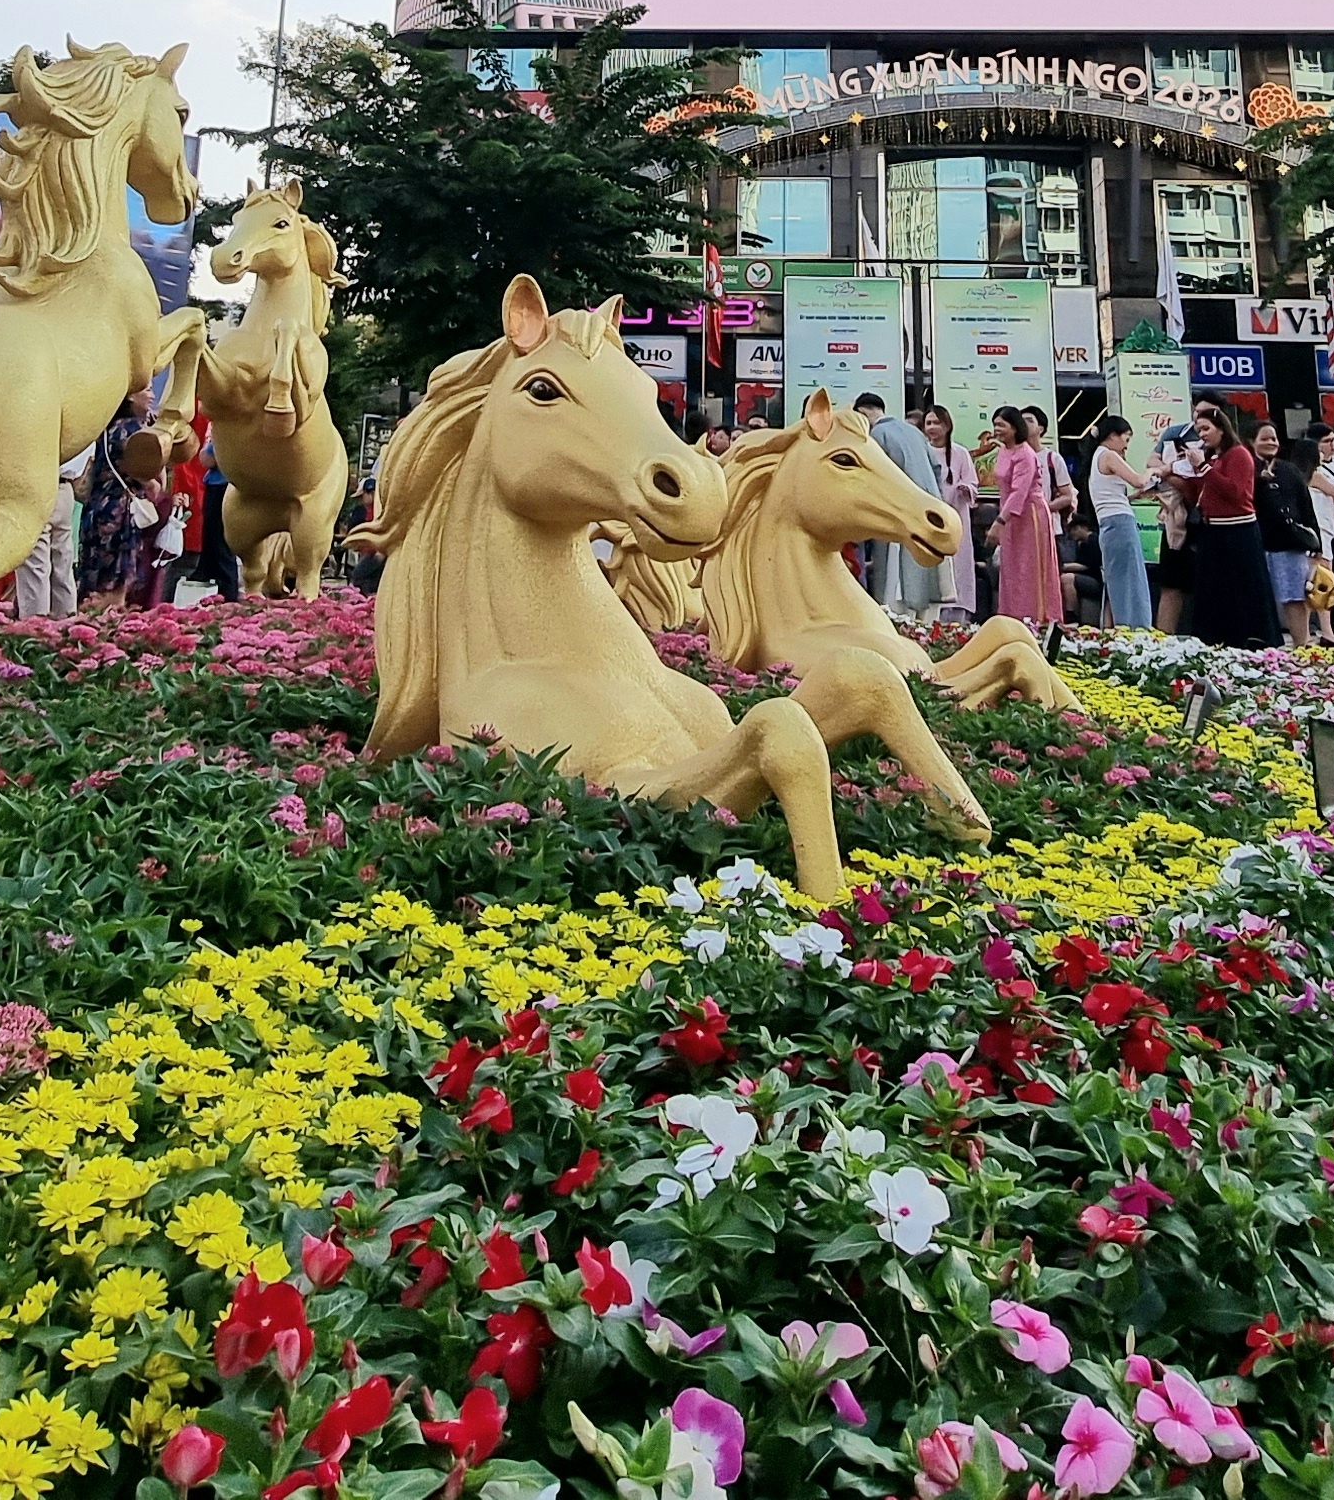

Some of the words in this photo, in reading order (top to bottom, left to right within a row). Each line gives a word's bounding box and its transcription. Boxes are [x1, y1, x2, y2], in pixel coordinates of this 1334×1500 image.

[865, 51, 971, 92] XUÂN
[978, 48, 1059, 85] BÍNH
[1067, 58, 1148, 103] NGỌ
[1154, 75, 1242, 123] 2026
[749, 346, 783, 362] AN
[1200, 356, 1255, 377] UOB
